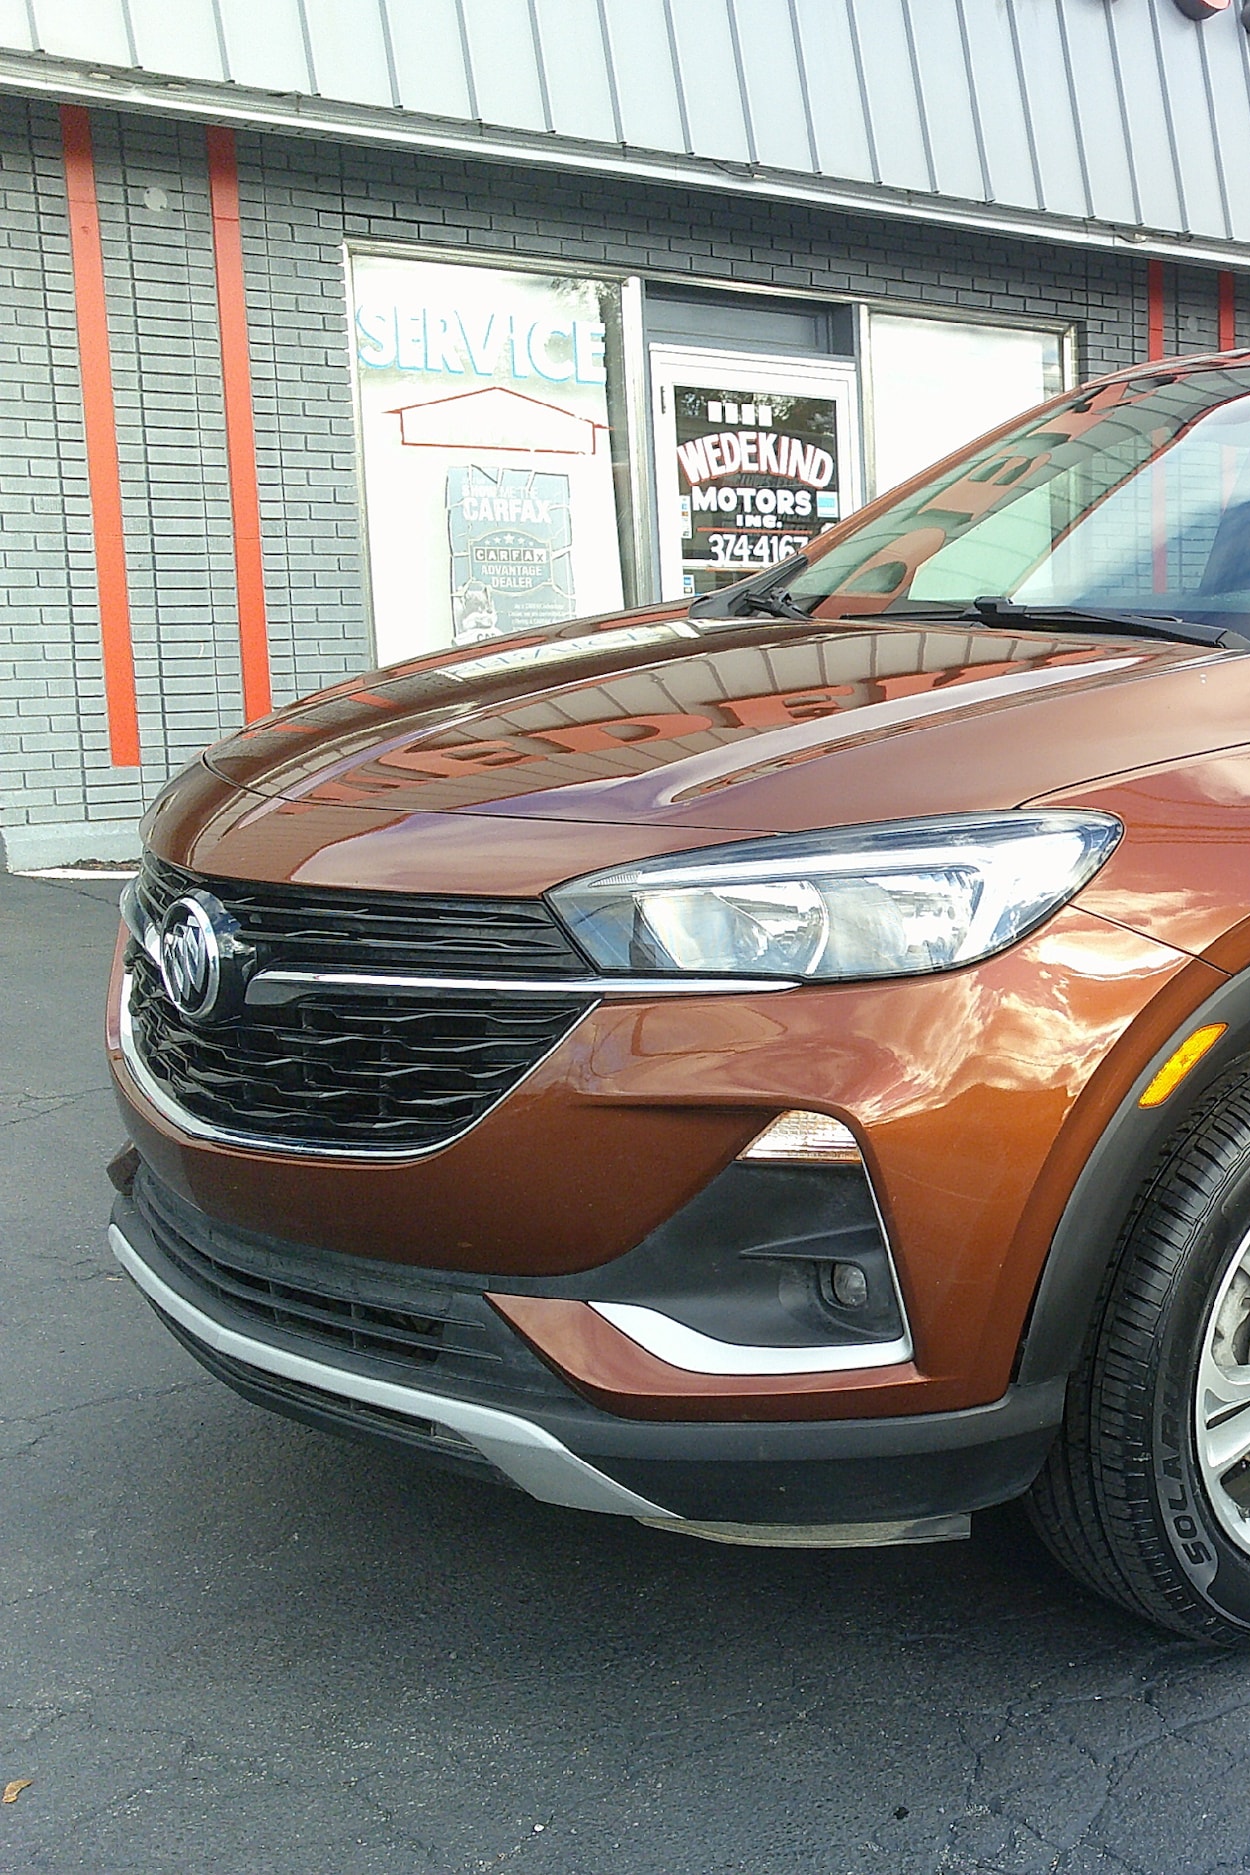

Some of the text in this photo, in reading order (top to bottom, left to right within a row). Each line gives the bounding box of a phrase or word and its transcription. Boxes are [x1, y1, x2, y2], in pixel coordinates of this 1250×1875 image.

[355, 303, 606, 385] SERVICE
[677, 431, 834, 489] WEDEKIND
[463, 497, 552, 523] CARFAX
[692, 485, 812, 516] MOTORS
[736, 514, 783, 529] INC.
[475, 548, 545, 562] CARFAX
[481, 565, 542, 576] ADVANTAGE
[492, 577, 532, 588] DEALER
